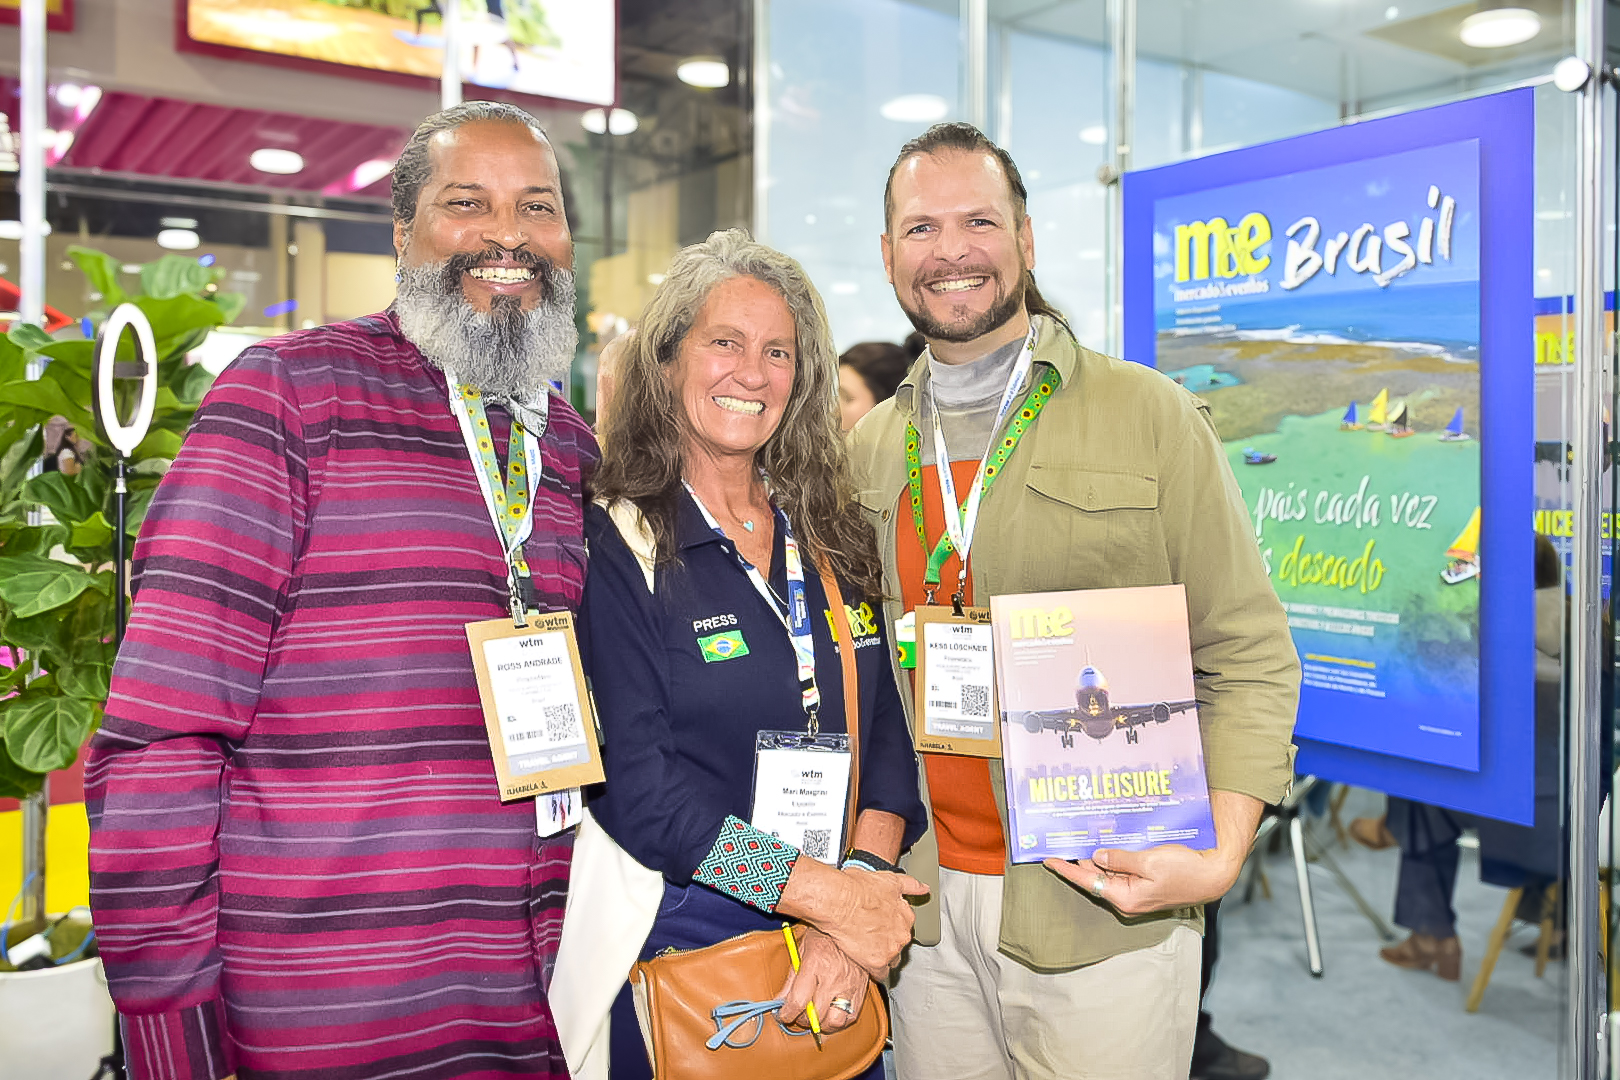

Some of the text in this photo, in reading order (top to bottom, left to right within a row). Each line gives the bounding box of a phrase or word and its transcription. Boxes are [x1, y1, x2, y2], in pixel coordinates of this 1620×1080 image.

[1175, 185, 1456, 290] m&e Brasil
[1314, 475, 1381, 529] cada
[1390, 491, 1438, 530] vez
[692, 613, 738, 633] PRESS
[952, 625, 973, 634] wtm
[519, 637, 543, 648] wtm
[801, 769, 823, 779] wtm
[1029, 769, 1174, 803] MICE&LEISURE
